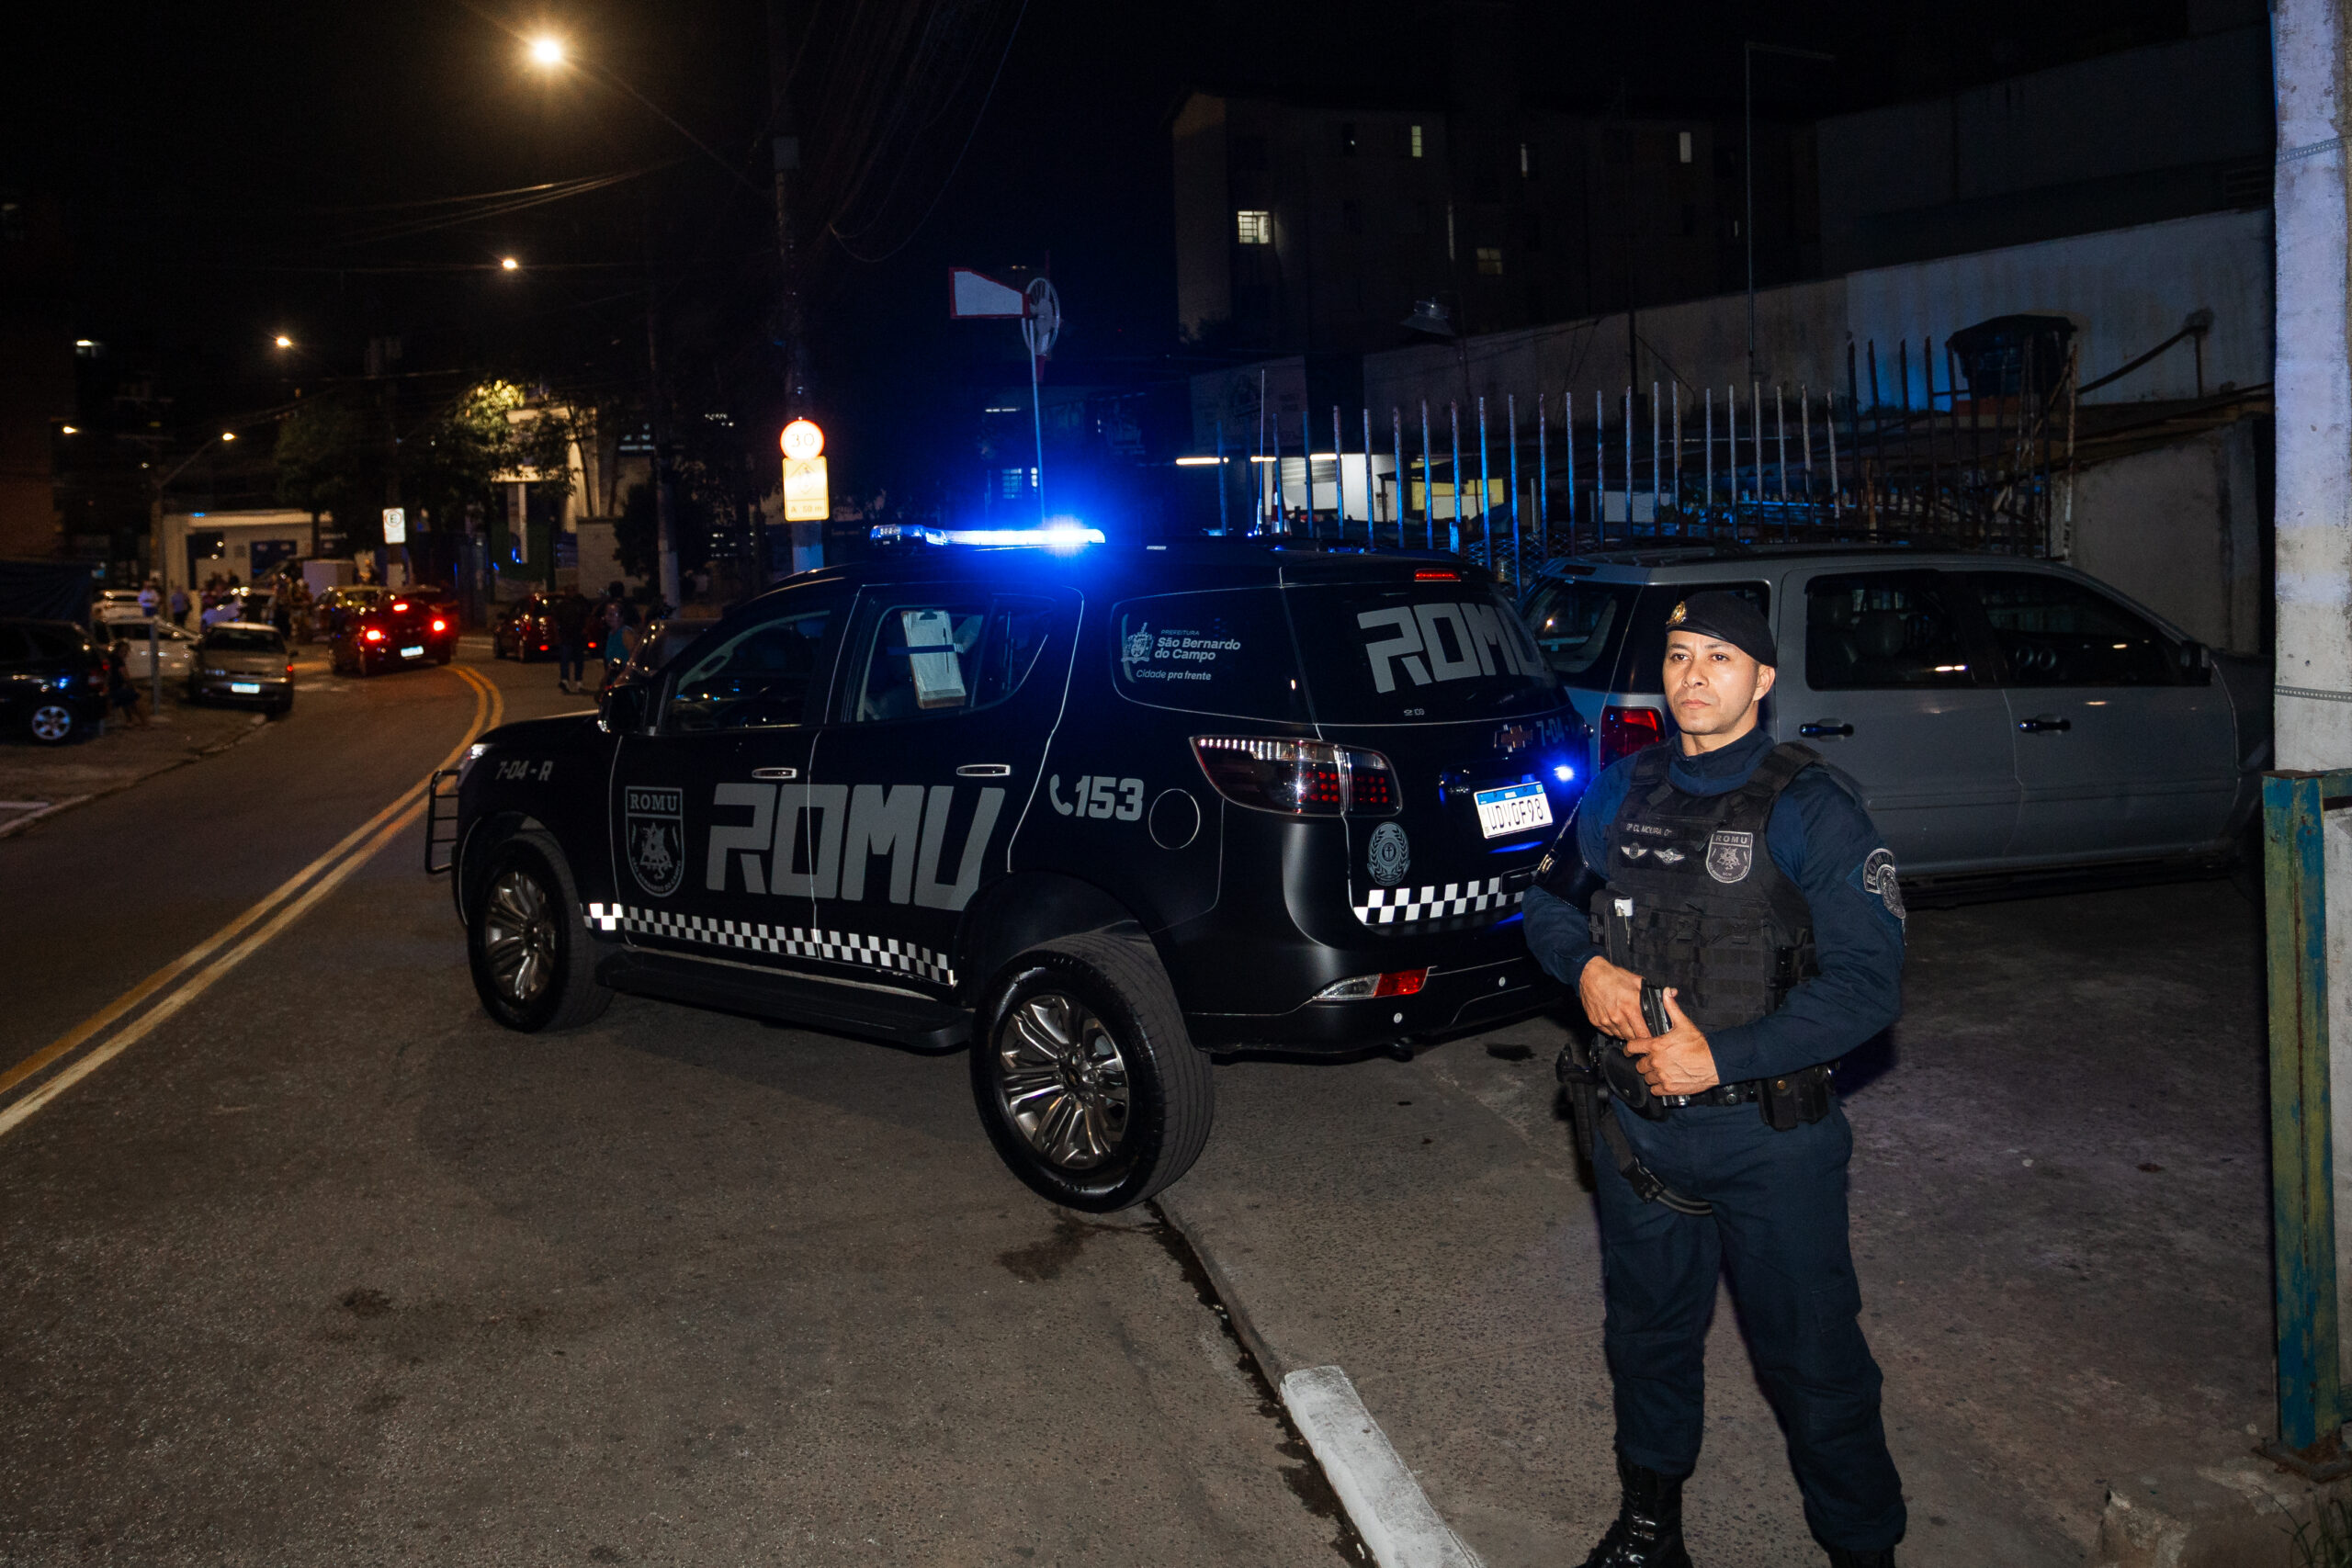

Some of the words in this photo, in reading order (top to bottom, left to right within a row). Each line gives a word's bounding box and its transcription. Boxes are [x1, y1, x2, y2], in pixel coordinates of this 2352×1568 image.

[791, 433, 815, 448] 30
[1157, 637, 1180, 648] São
[1182, 637, 1241, 650] Bernardo
[1154, 648, 1170, 659] do
[1172, 649, 1216, 663] Campo
[1136, 669, 1166, 679] Cidade
[1167, 671, 1183, 682] pra
[1184, 670, 1212, 681] frente
[629, 793, 678, 812] ROMU
[1075, 775, 1144, 821] 153
[1715, 834, 1747, 844] ROMU
[706, 783, 1006, 911] ROMU
